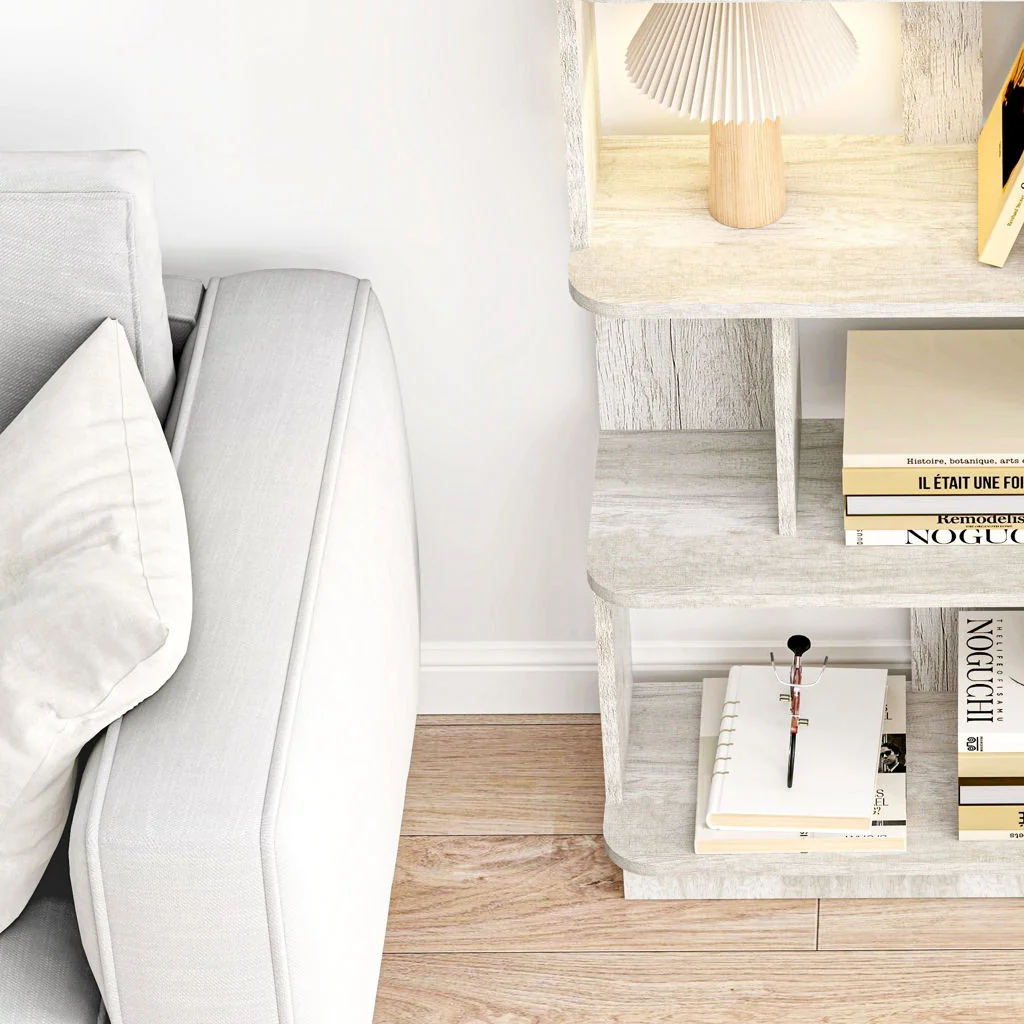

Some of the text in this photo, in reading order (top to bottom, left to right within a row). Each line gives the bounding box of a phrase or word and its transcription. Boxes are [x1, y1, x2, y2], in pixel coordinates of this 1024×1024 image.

[906, 456, 947, 466] Histoire,
[949, 456, 997, 466] botanique,
[918, 476, 931, 490] IL
[933, 473, 970, 490] ÉTAIT
[973, 476, 1000, 490] UNE
[966, 618, 994, 723] NOGUCHI
